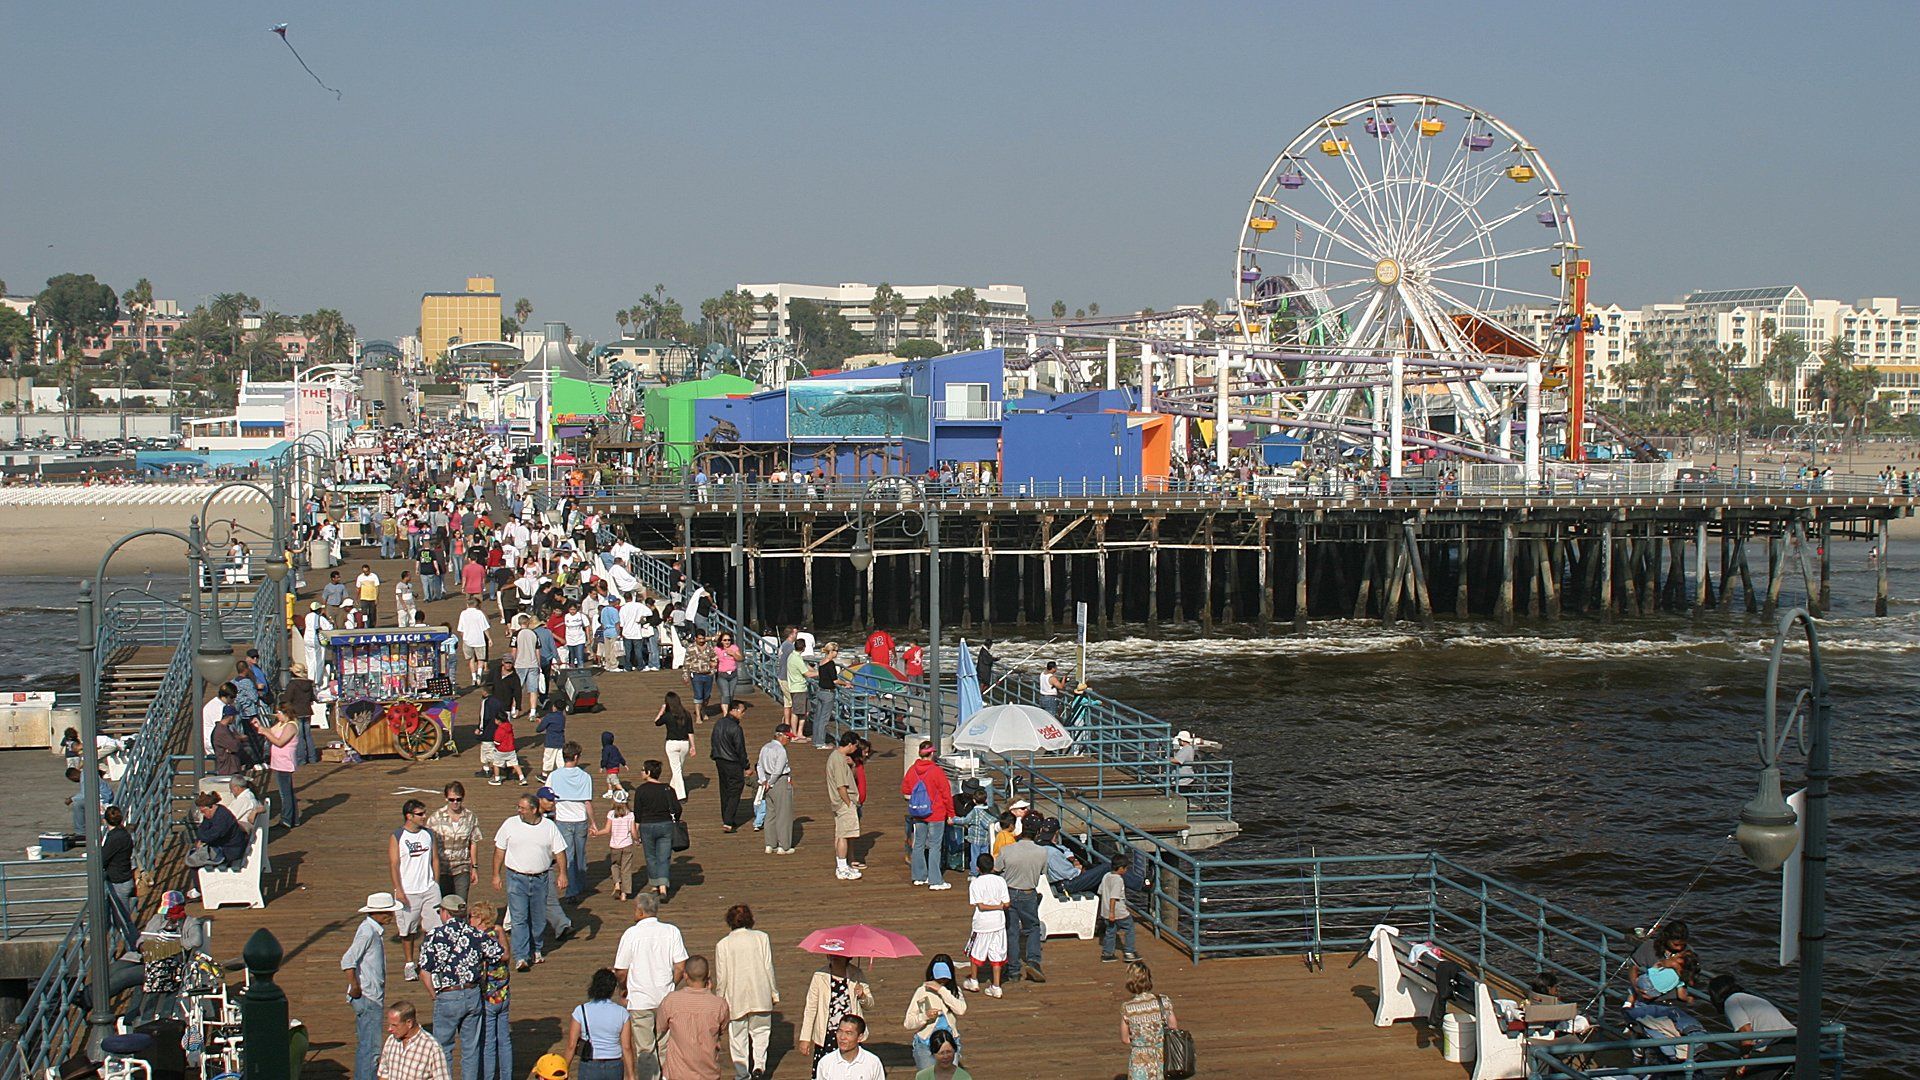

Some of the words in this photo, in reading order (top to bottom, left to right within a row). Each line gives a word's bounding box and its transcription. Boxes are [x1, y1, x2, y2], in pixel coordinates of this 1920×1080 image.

[301, 389, 327, 398] THE
[360, 635, 382, 643] L.A.
[385, 632, 421, 642] BEACH
